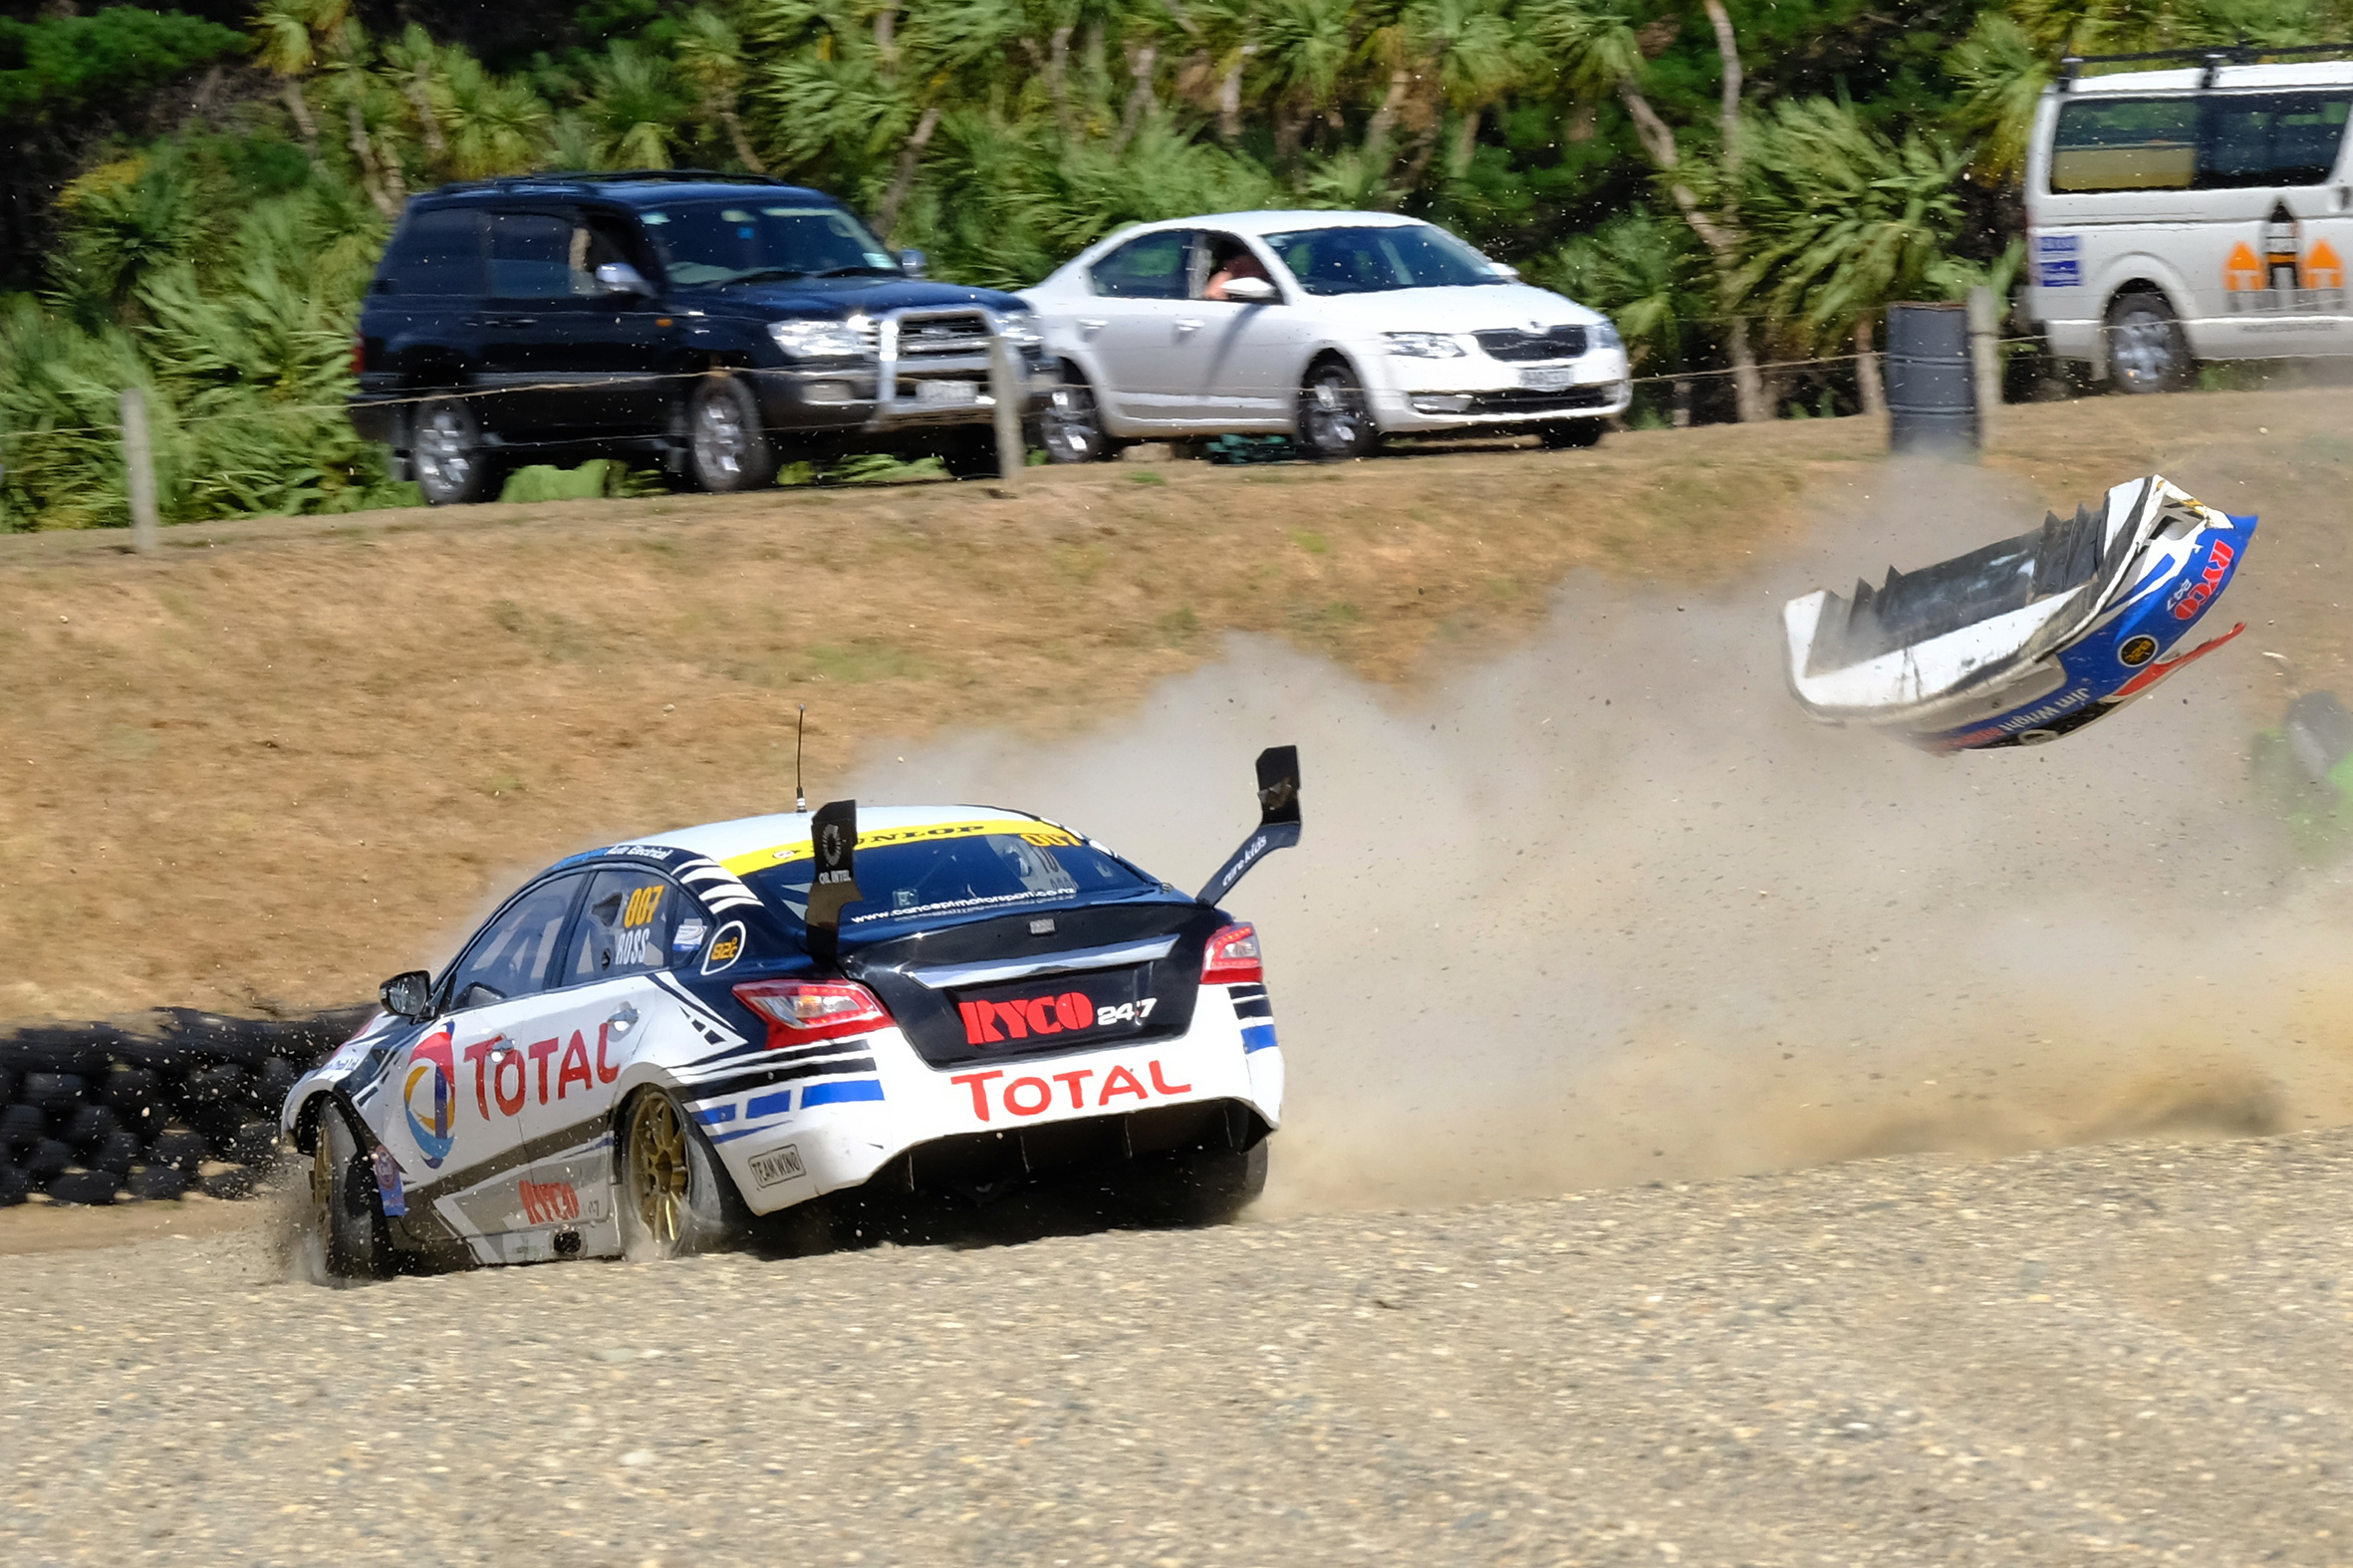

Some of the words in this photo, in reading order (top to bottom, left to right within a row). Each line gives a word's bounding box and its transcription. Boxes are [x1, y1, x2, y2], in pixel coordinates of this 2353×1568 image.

[2175, 538, 2234, 621] RYCO
[2055, 687, 2091, 708] Jim
[1997, 704, 2058, 732] Wright
[1020, 834, 1083, 847] 007
[1244, 835, 1267, 864] kids
[624, 885, 664, 928] 007
[615, 927, 650, 965] ROSS
[958, 990, 1094, 1046] RYCO
[462, 1023, 623, 1123] TOTAL
[950, 1060, 1192, 1123] TOTAL
[751, 1158, 778, 1182] TEAM
[518, 1179, 580, 1225] RYCO
